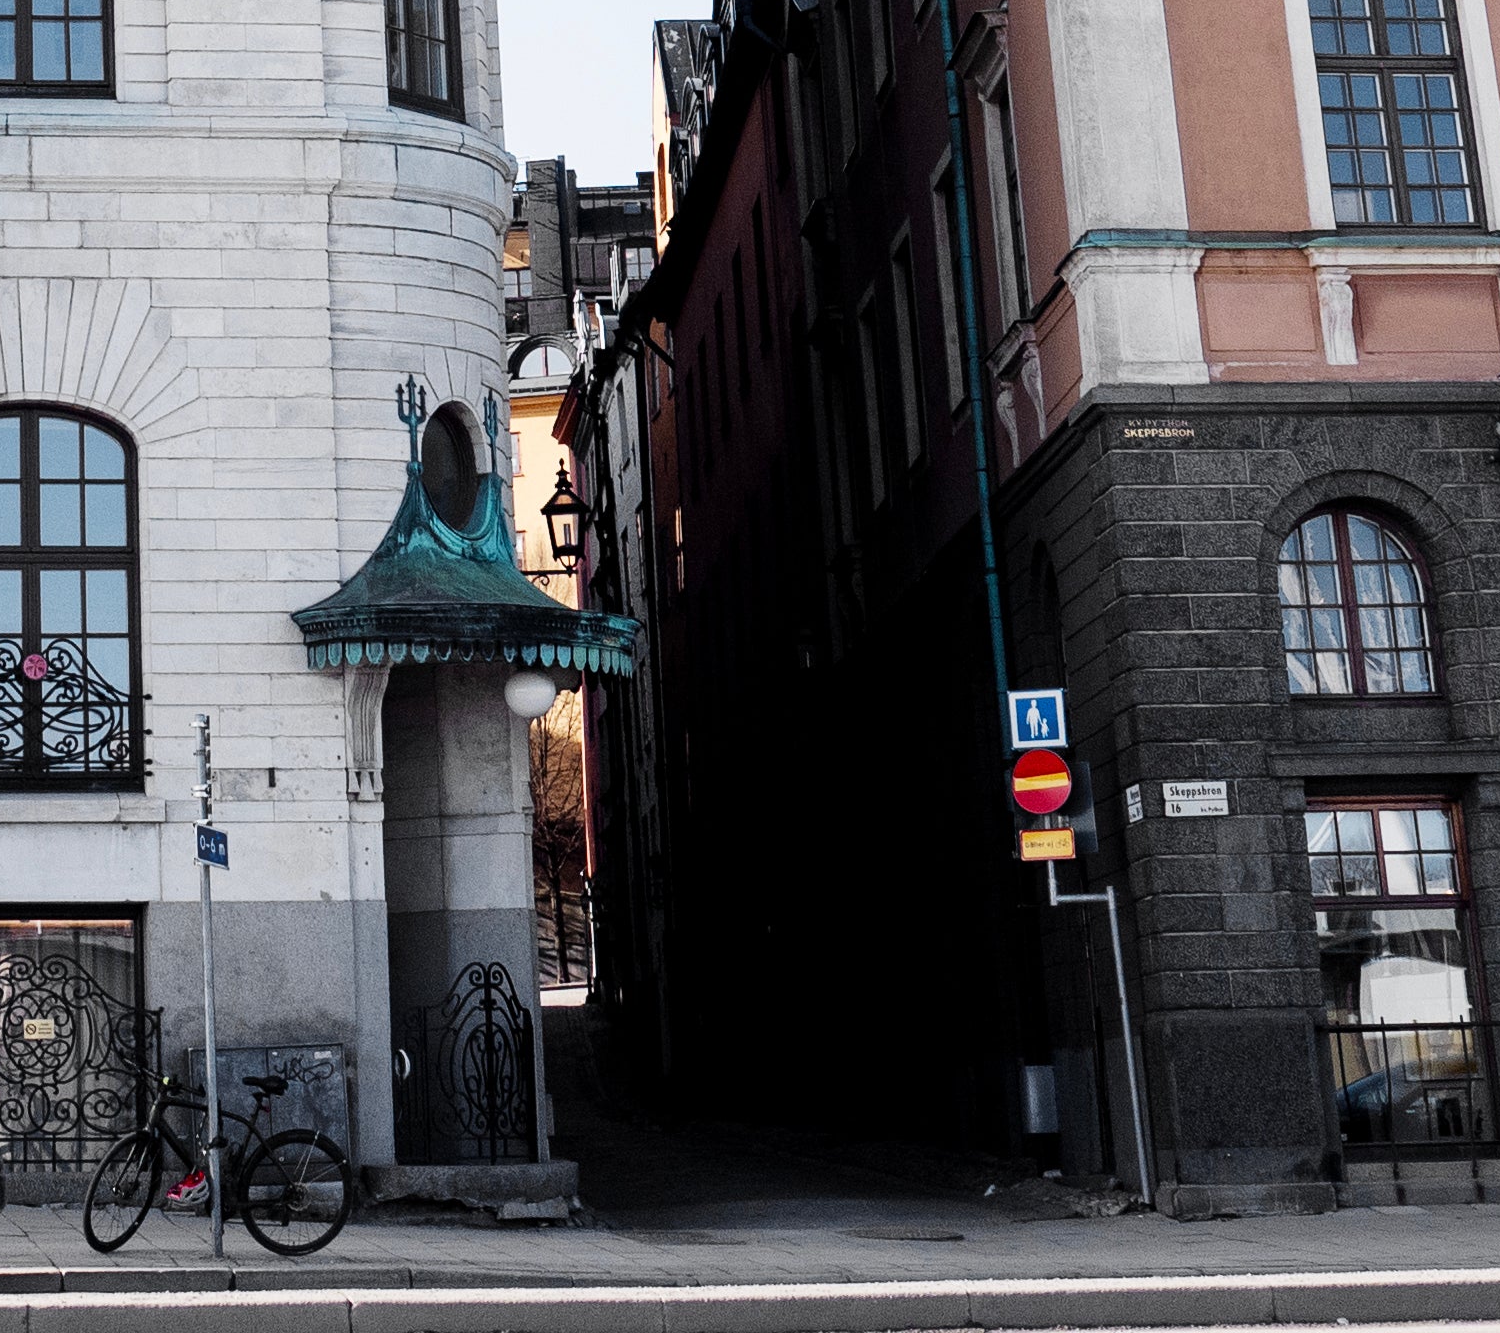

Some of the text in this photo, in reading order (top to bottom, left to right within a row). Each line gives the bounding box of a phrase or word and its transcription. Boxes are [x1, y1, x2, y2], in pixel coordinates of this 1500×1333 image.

[1124, 428, 1195, 438] SKEPPSBRON
[1169, 785, 1223, 799] Skeppsbron
[1171, 803, 1182, 814] 16
[200, 834, 216, 853] 0-6
